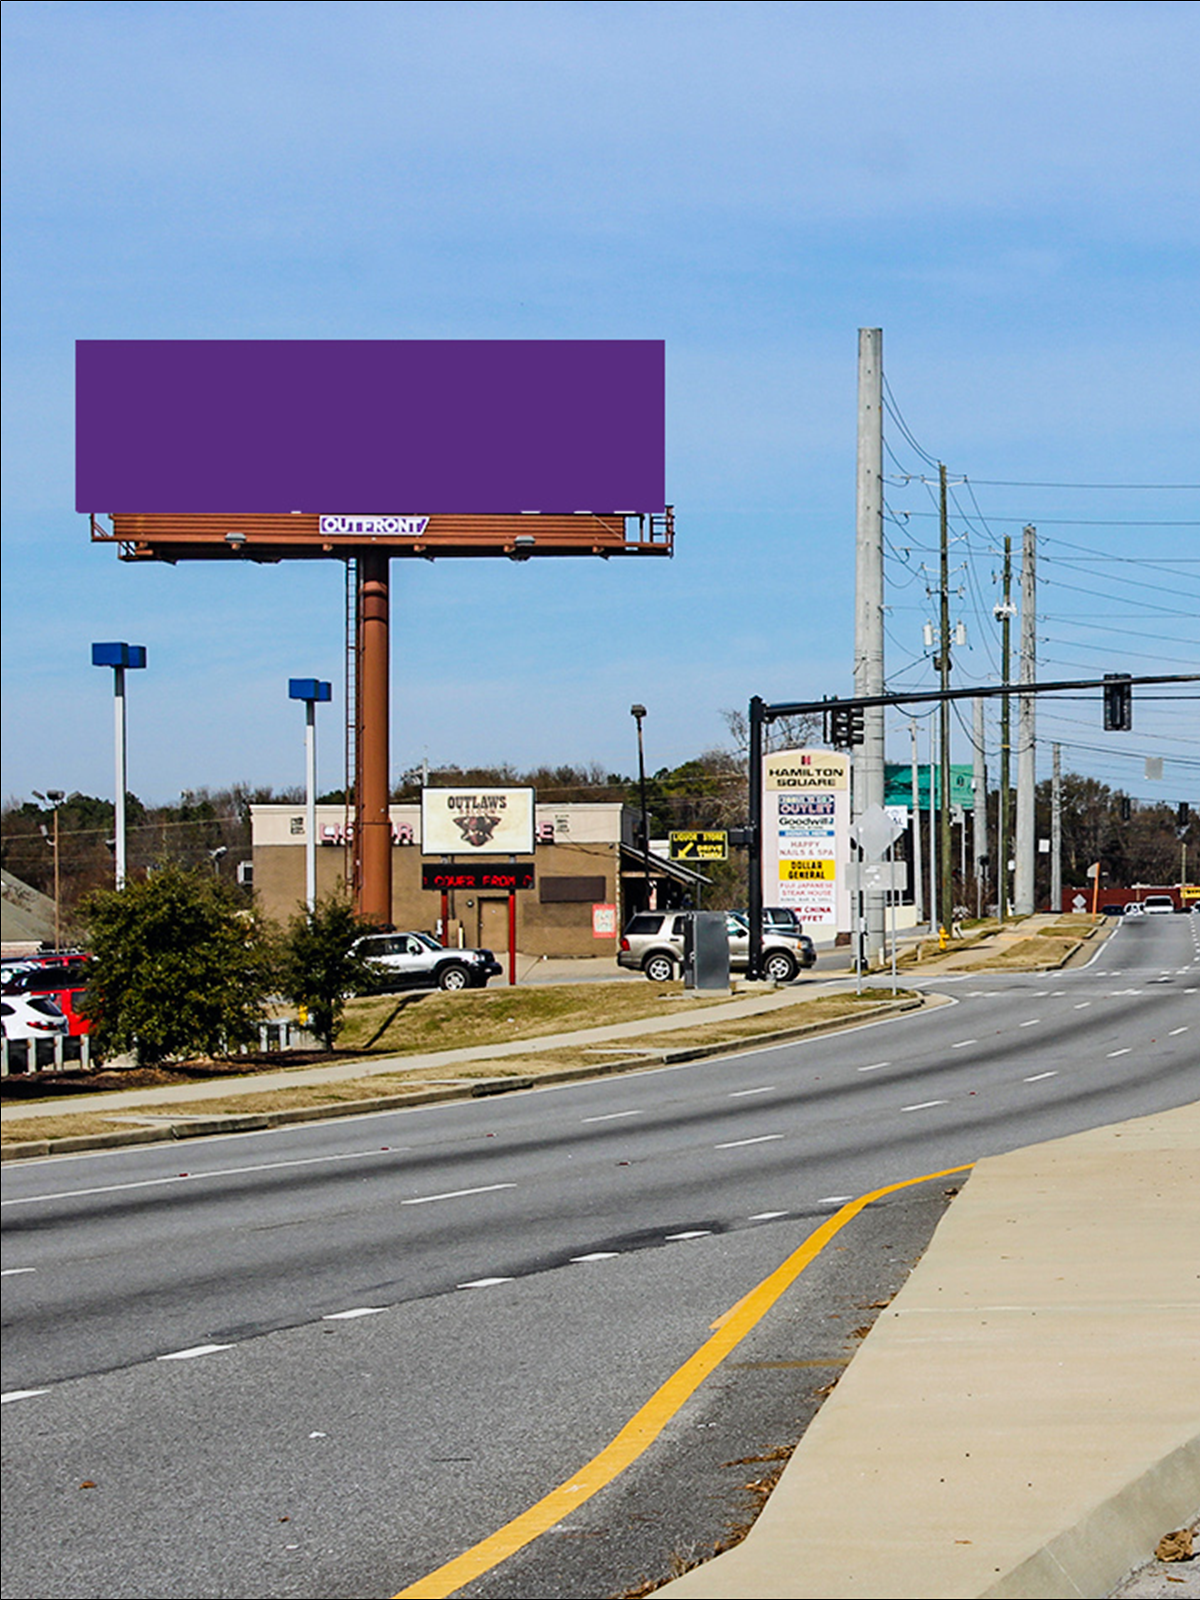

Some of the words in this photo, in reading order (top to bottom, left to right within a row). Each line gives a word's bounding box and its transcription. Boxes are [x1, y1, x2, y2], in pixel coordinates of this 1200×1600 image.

[323, 517, 423, 533] OUTFRONT
[769, 768, 844, 777] HAMILTON
[777, 778, 836, 787] SQUARE
[447, 795, 507, 809] OUTLAWS
[781, 804, 833, 814] OUTLET
[779, 817, 828, 825] Goodwill
[791, 861, 823, 870] DOLLAR
[788, 871, 825, 880] GENERAL
[804, 905, 832, 913] CHINA
